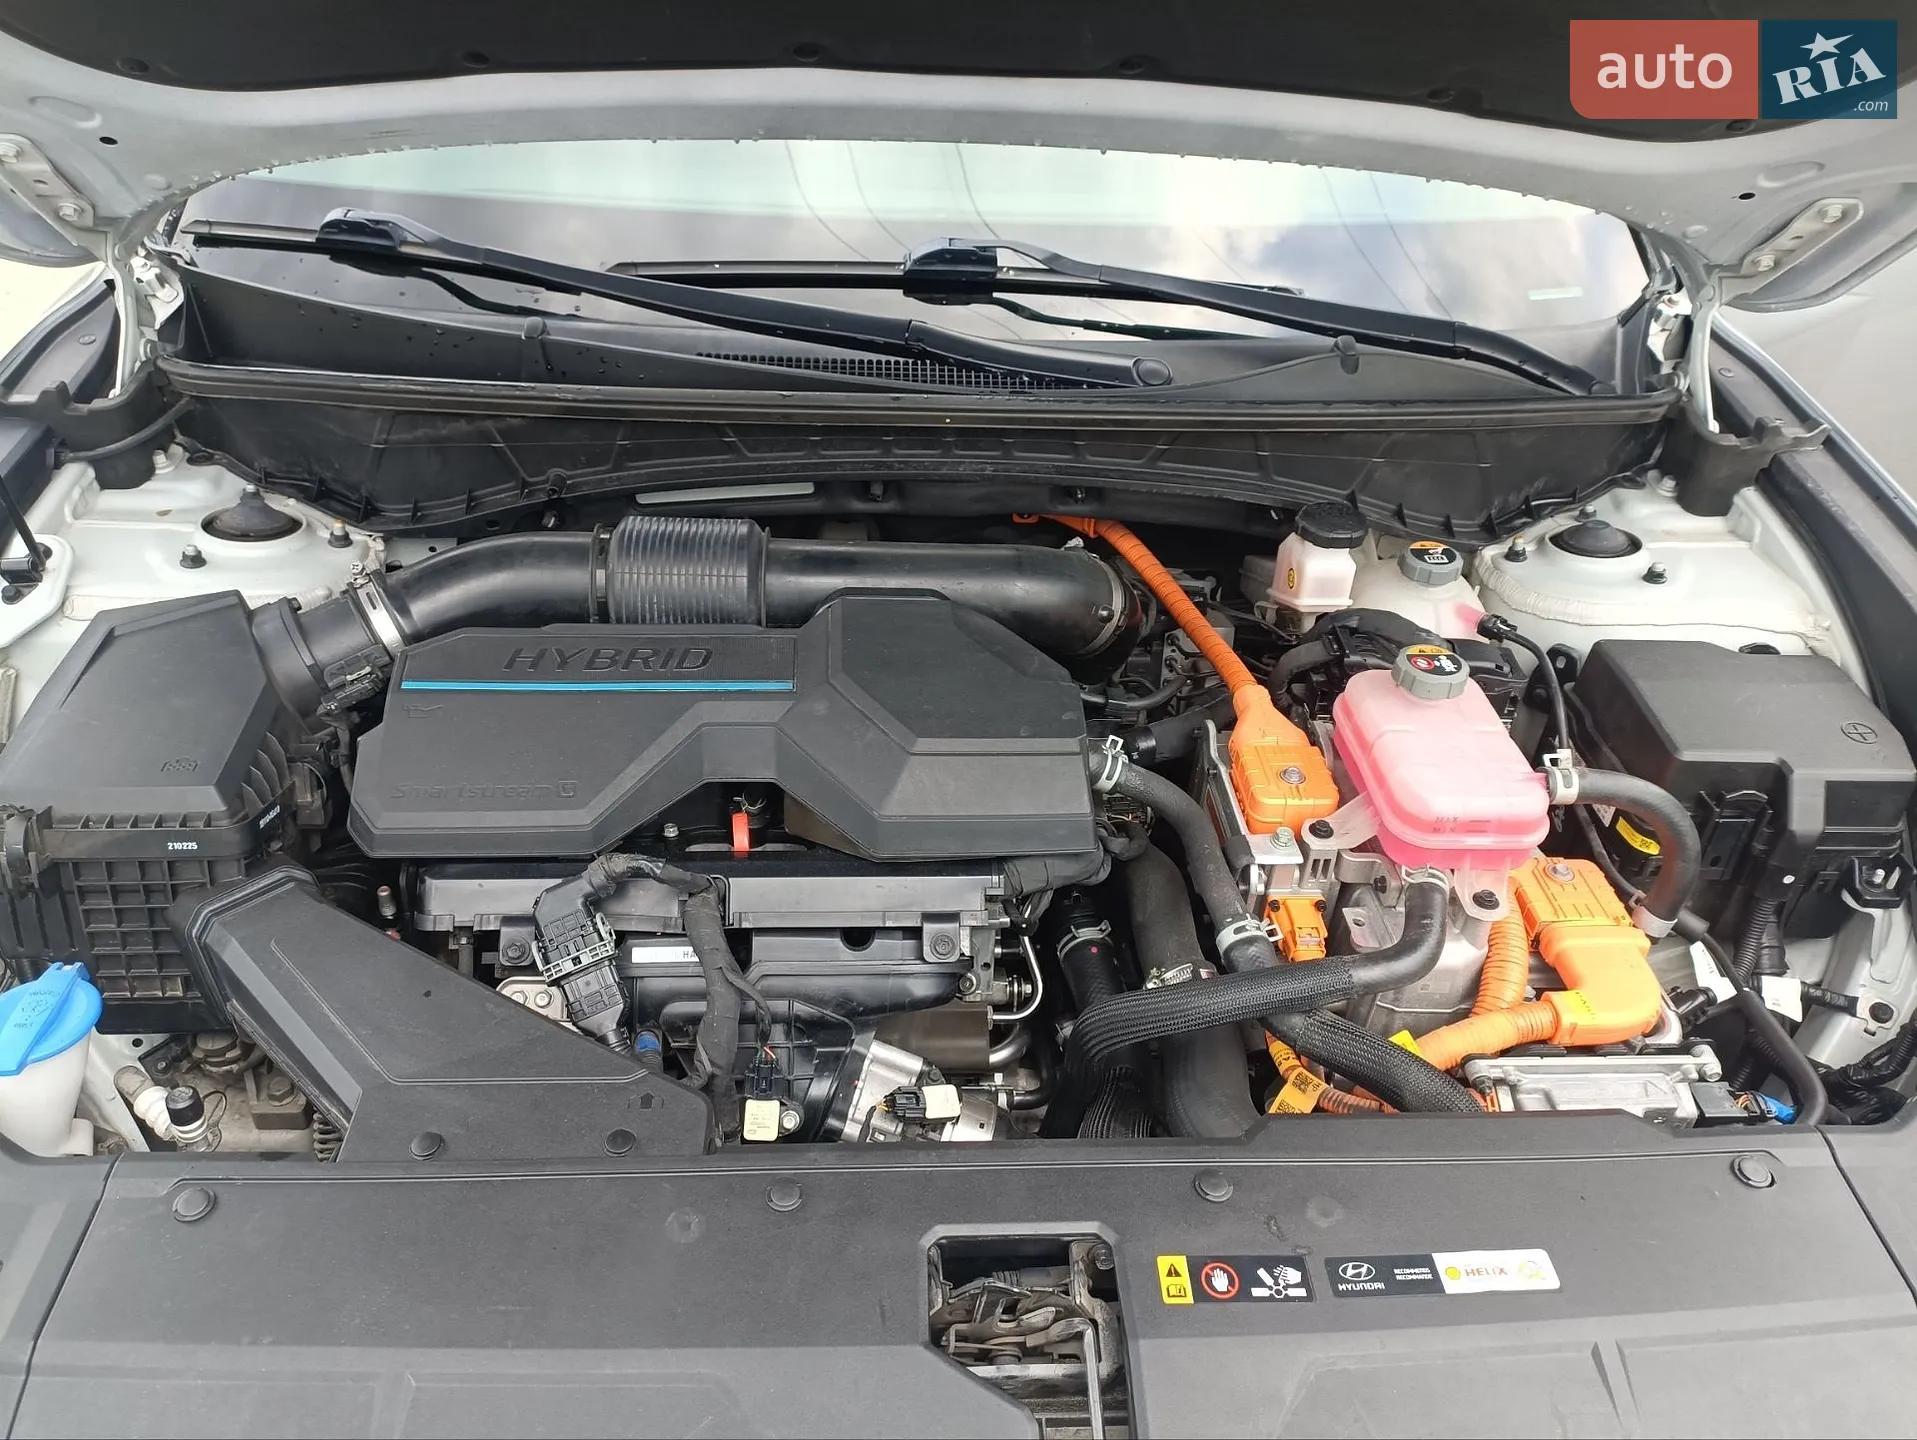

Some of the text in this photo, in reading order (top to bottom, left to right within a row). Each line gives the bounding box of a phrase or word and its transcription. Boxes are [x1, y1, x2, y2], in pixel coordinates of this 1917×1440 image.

[503, 647, 713, 672] HYBRID
[167, 842, 198, 851] 210225
[1465, 1267, 1509, 1277] HELIX
[1338, 1282, 1386, 1292] HYUNDAI
